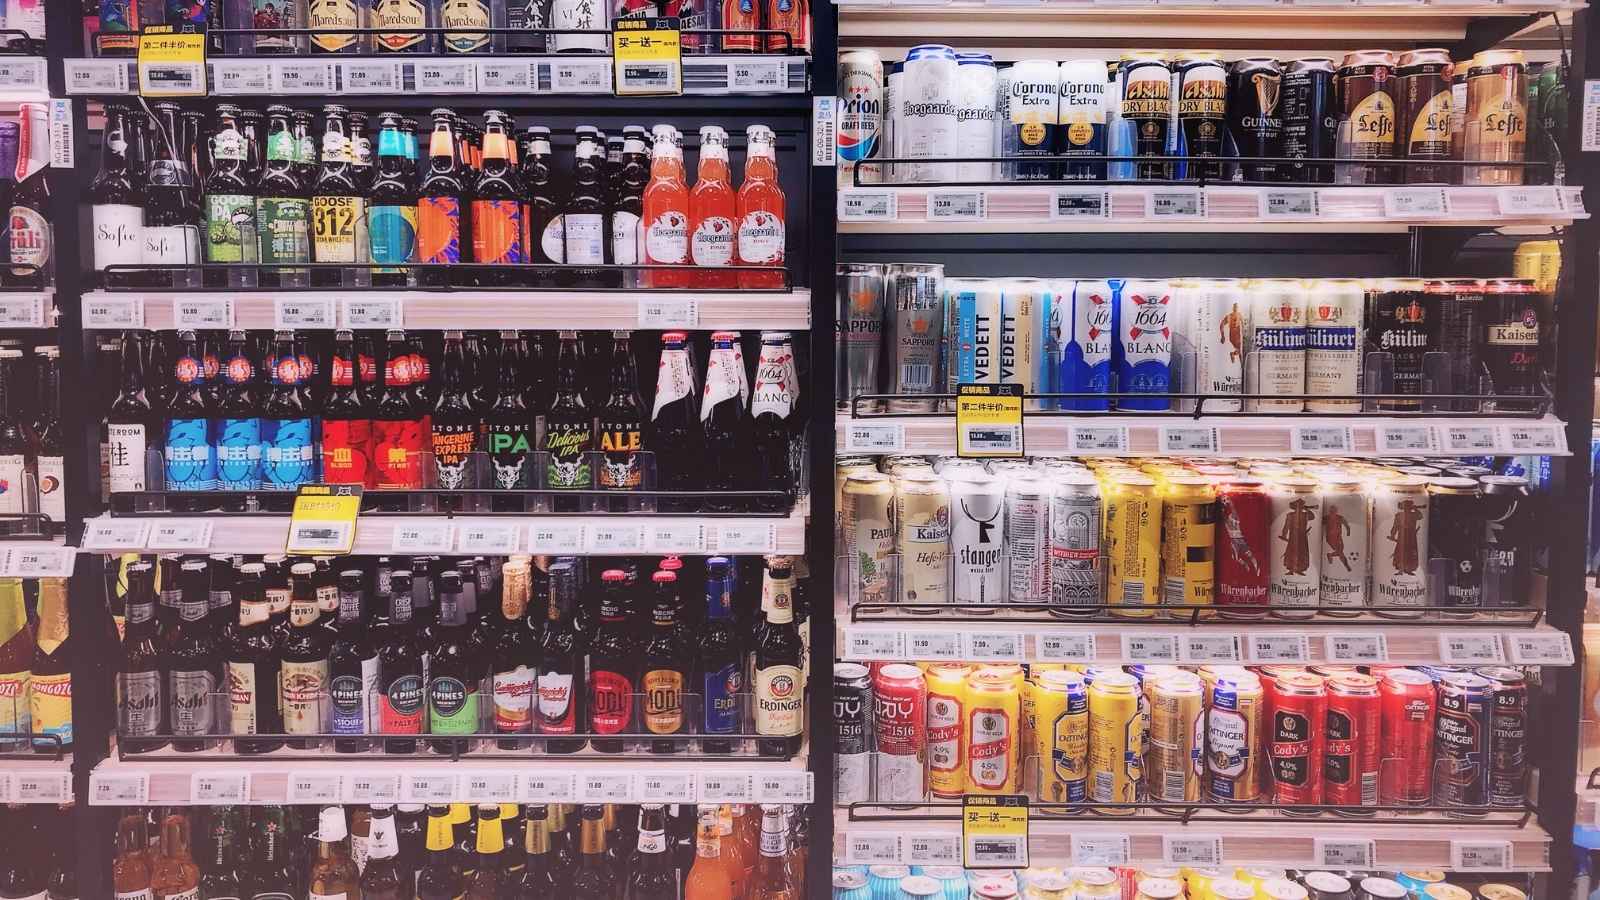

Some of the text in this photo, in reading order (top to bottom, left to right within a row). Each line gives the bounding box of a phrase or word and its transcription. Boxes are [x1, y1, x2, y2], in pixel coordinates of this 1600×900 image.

[619, 37, 662, 47] 买一送一
[1022, 95, 1050, 105] Extra
[1070, 95, 1098, 105] Extra
[1123, 101, 1142, 112] DRY
[1179, 101, 1200, 112] DRY
[1358, 114, 1393, 138] Leffe
[314, 197, 353, 207] GOOSE
[315, 207, 353, 237] 312
[1135, 311, 1167, 327] 1664
[975, 314, 990, 381] VEDETT
[1002, 313, 1016, 381] VEDETT
[547, 429, 591, 449] Delicious
[602, 431, 641, 451] ALE
[435, 444, 471, 456] EXPRESS
[560, 445, 580, 457] IPA
[443, 455, 459, 465] IPA
[437, 692, 463, 700] PINES
[1499, 695, 1515, 705] 8.9
[1444, 697, 1460, 709] 8.9
[840, 724, 862, 736] 1516
[891, 726, 914, 736] 1516
[974, 742, 1008, 756] Cody's
[1273, 743, 1308, 755] Cody's
[968, 812, 1011, 822] 买一送一
